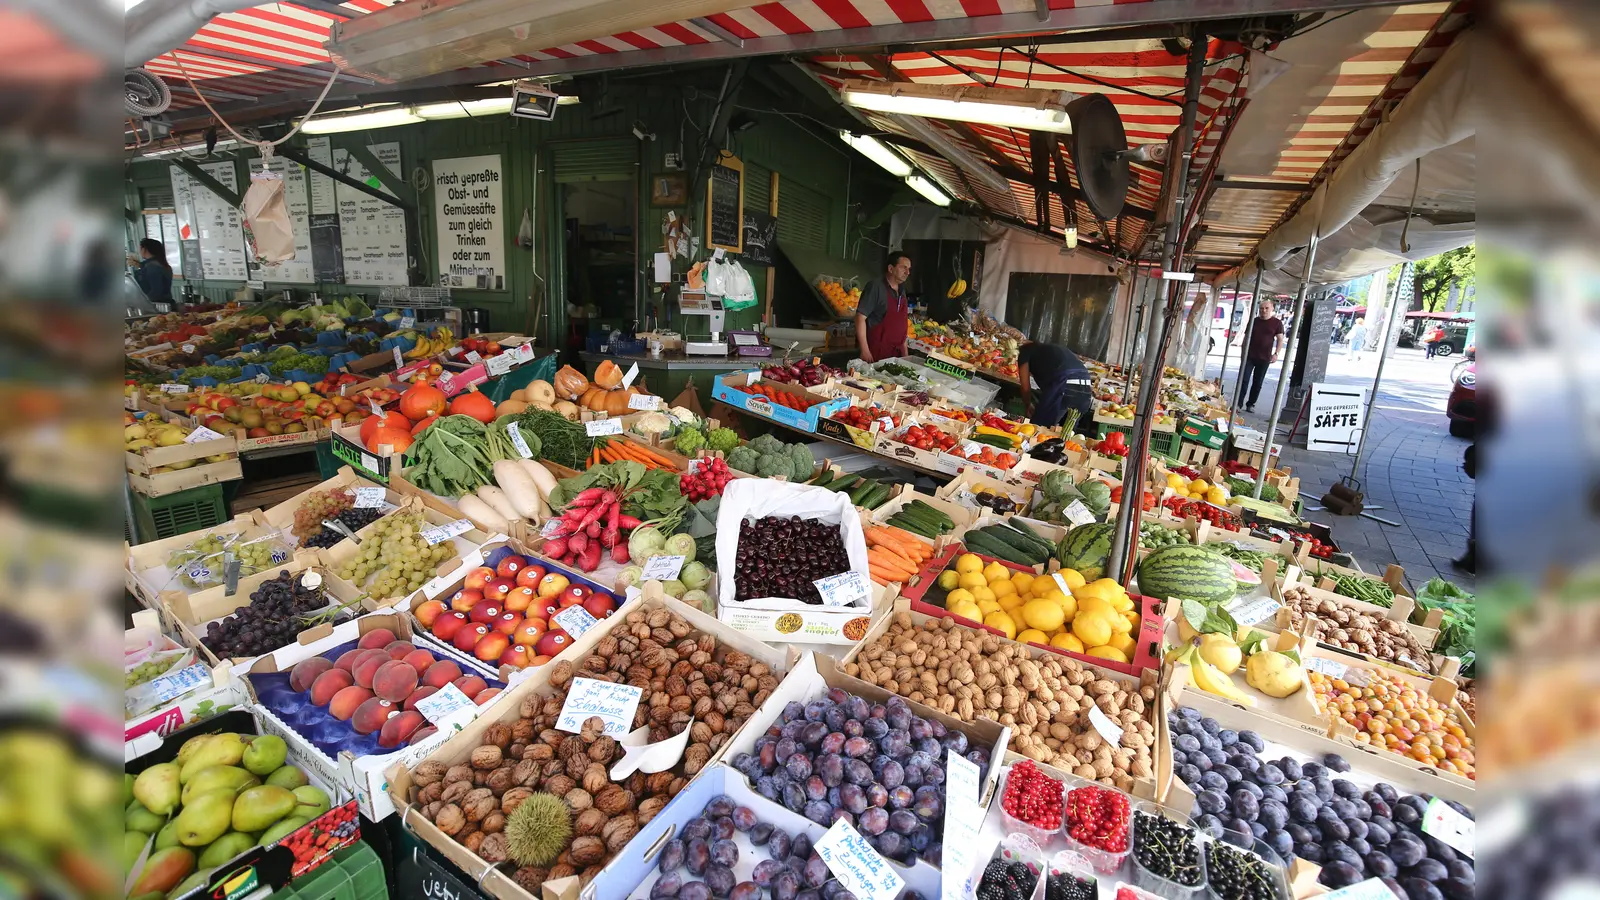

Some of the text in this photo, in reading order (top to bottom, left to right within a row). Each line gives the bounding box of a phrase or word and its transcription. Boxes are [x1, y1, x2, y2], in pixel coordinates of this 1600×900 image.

[461, 169, 499, 187] gepreßte
[448, 186, 489, 200] Obst- und
[443, 202, 496, 216] Gemüsesäfte
[448, 218, 492, 234] zum gleich
[456, 234, 486, 246] Trinken
[452, 249, 491, 261] oder zum
[926, 358, 968, 378] CASTELLO
[747, 399, 772, 414] Savéol
[1314, 411, 1358, 428] SÄFTE
[332, 440, 361, 466] CASTE
[226, 879, 259, 900] Oswald
